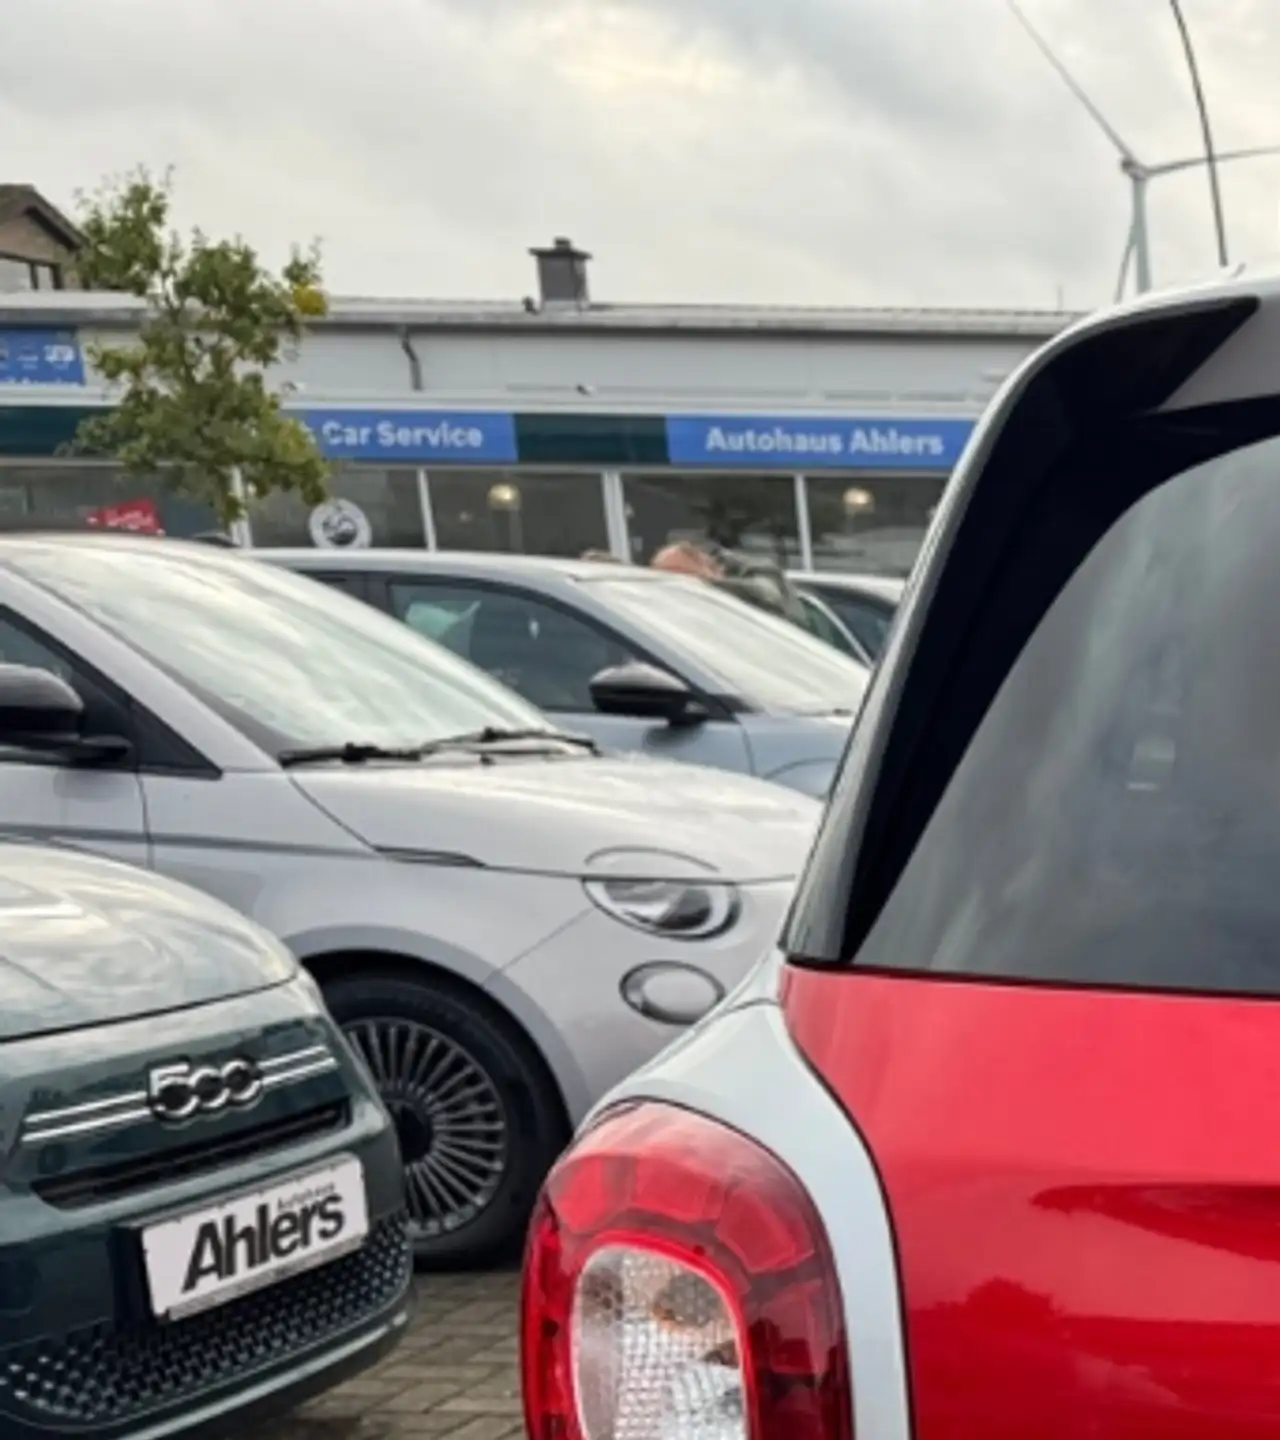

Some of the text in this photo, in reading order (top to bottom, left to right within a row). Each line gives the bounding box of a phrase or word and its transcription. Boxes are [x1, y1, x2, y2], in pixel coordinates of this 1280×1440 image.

[321, 420, 371, 446] Car
[375, 420, 484, 448] Service
[705, 425, 945, 456] Autohaus Ahlers
[149, 1059, 261, 1118] 500
[180, 1193, 344, 1294] Ahlers
